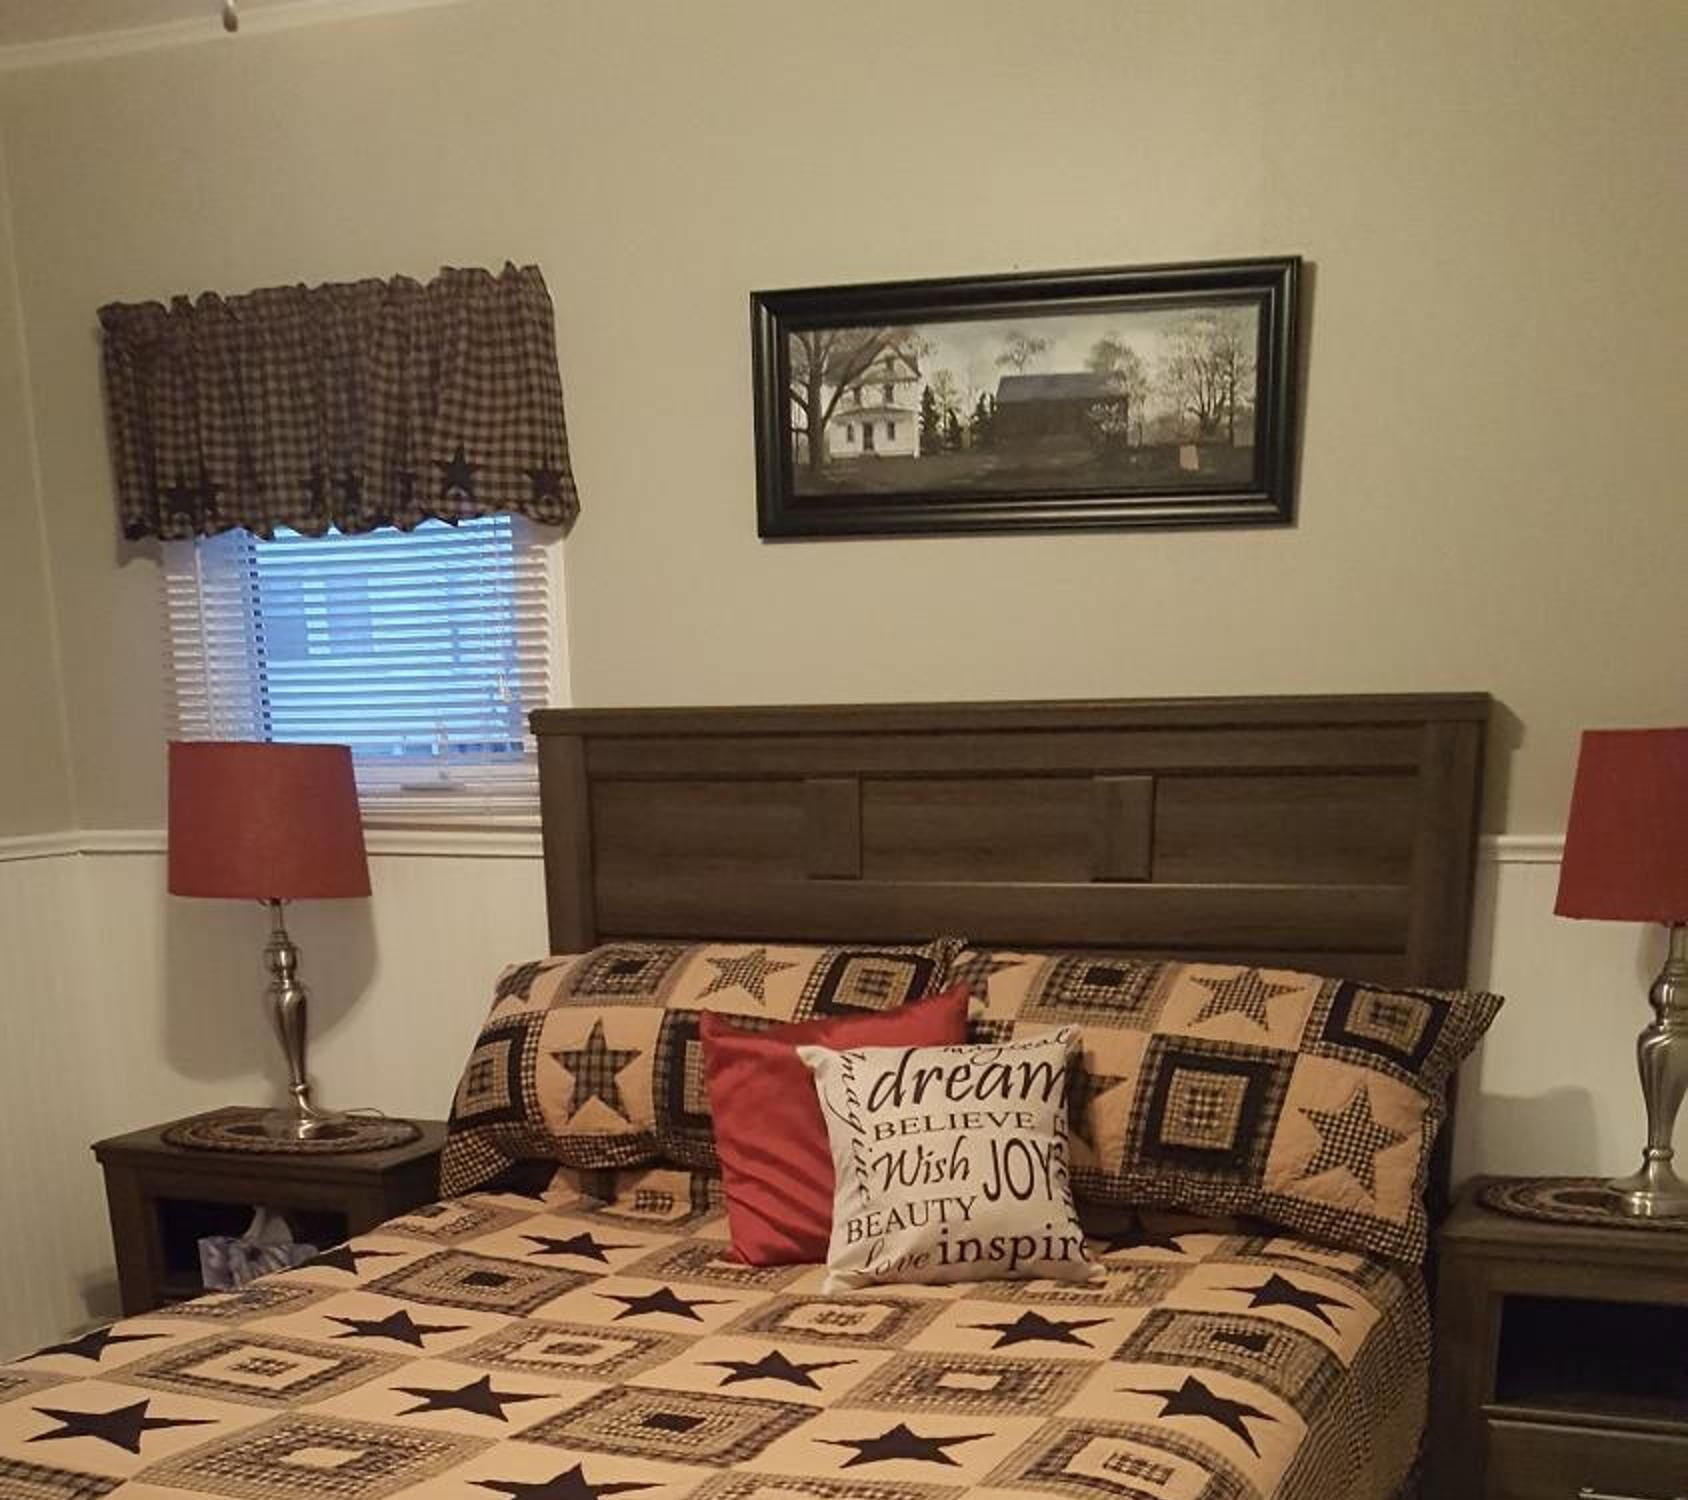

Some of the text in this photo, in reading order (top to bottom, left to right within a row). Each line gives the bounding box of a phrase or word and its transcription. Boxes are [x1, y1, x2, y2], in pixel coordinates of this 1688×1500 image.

[866, 1047, 1067, 1113] dream
[872, 1111, 1037, 1142] BELIEVE
[871, 1135, 971, 1192] Wish
[982, 1137, 1054, 1202] JOY
[846, 1195, 978, 1245] BEAUTY
